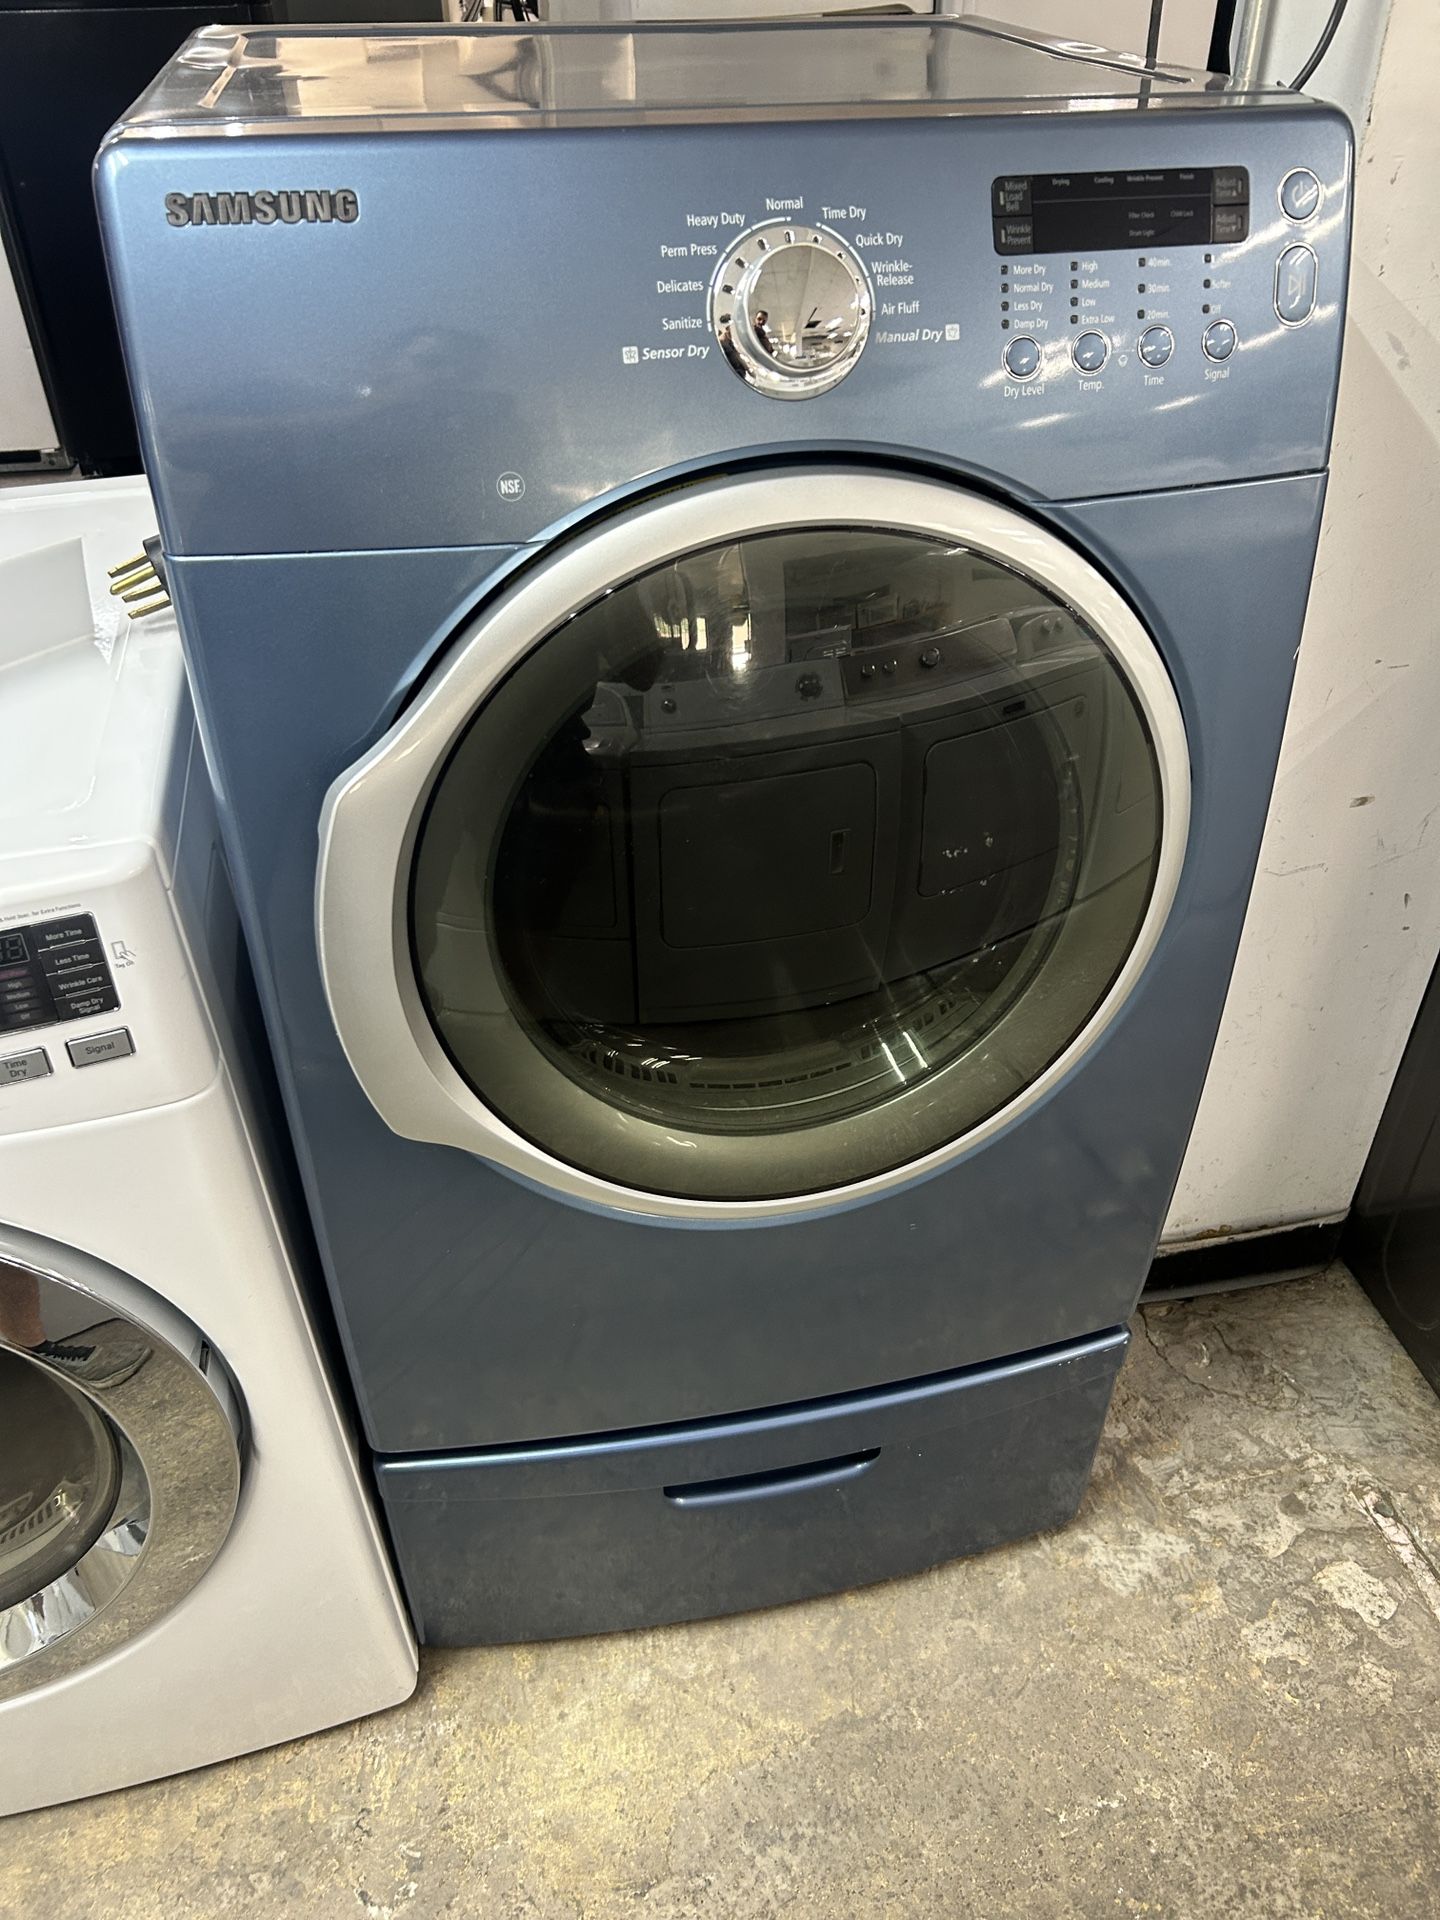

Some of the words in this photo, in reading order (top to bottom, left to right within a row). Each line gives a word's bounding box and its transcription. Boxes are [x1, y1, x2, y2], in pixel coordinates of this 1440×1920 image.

[1005, 180, 1027, 191] Mixed
[766, 196, 804, 211] Normal
[1005, 191, 1023, 202] Load
[166, 189, 358, 227] SAMSUNG
[822, 207, 847, 220] Time
[849, 205, 867, 220] Dry
[686, 214, 719, 228] Heavy
[721, 212, 745, 227] Duty
[1006, 224, 1031, 235] Wrinkle
[856, 234, 884, 248] Quick
[886, 232, 903, 248] Dry
[661, 245, 688, 258] Perm
[690, 243, 717, 256] Press
[872, 260, 913, 274] Wrinkle-
[1013, 265, 1033, 276] More
[1034, 264, 1046, 276] Dry
[1082, 261, 1099, 274] High
[657, 280, 704, 293] Delicates
[877, 274, 914, 286] Release
[1082, 279, 1110, 290] Medium
[1013, 283, 1040, 294] Normal
[1042, 281, 1054, 295] Dry
[881, 303, 895, 315] Air
[898, 301, 920, 314] Fluff
[1013, 301, 1029, 312] Less
[1031, 300, 1043, 313] Dry
[1082, 298, 1097, 308] Low
[662, 316, 703, 330] Sanitize
[1014, 319, 1034, 330] Damp
[1036, 318, 1049, 330] Dry
[1082, 316, 1099, 326] Extra
[1100, 314, 1115, 325] Low
[875, 329, 919, 344] Manual
[922, 328, 943, 343] Dry
[642, 347, 685, 360] Sensor
[687, 344, 710, 359] Dry
[1144, 374, 1165, 387] Time
[1204, 367, 1230, 383] Signal
[1003, 384, 1020, 400] Dry
[1021, 382, 1045, 397] Level
[1078, 380, 1104, 394] Temp.
[45, 933, 65, 942] More
[65, 928, 83, 938] Time
[55, 956, 73, 966] Less
[73, 952, 90, 962] Time
[58, 979, 86, 992] Wrinkle
[86, 975, 103, 986] Care
[71, 999, 90, 1010] Damp
[91, 996, 104, 1007] Dry
[85, 1042, 116, 1056] Signal
[3, 1061, 28, 1070] Time
[9, 1070, 27, 1080] Dry
